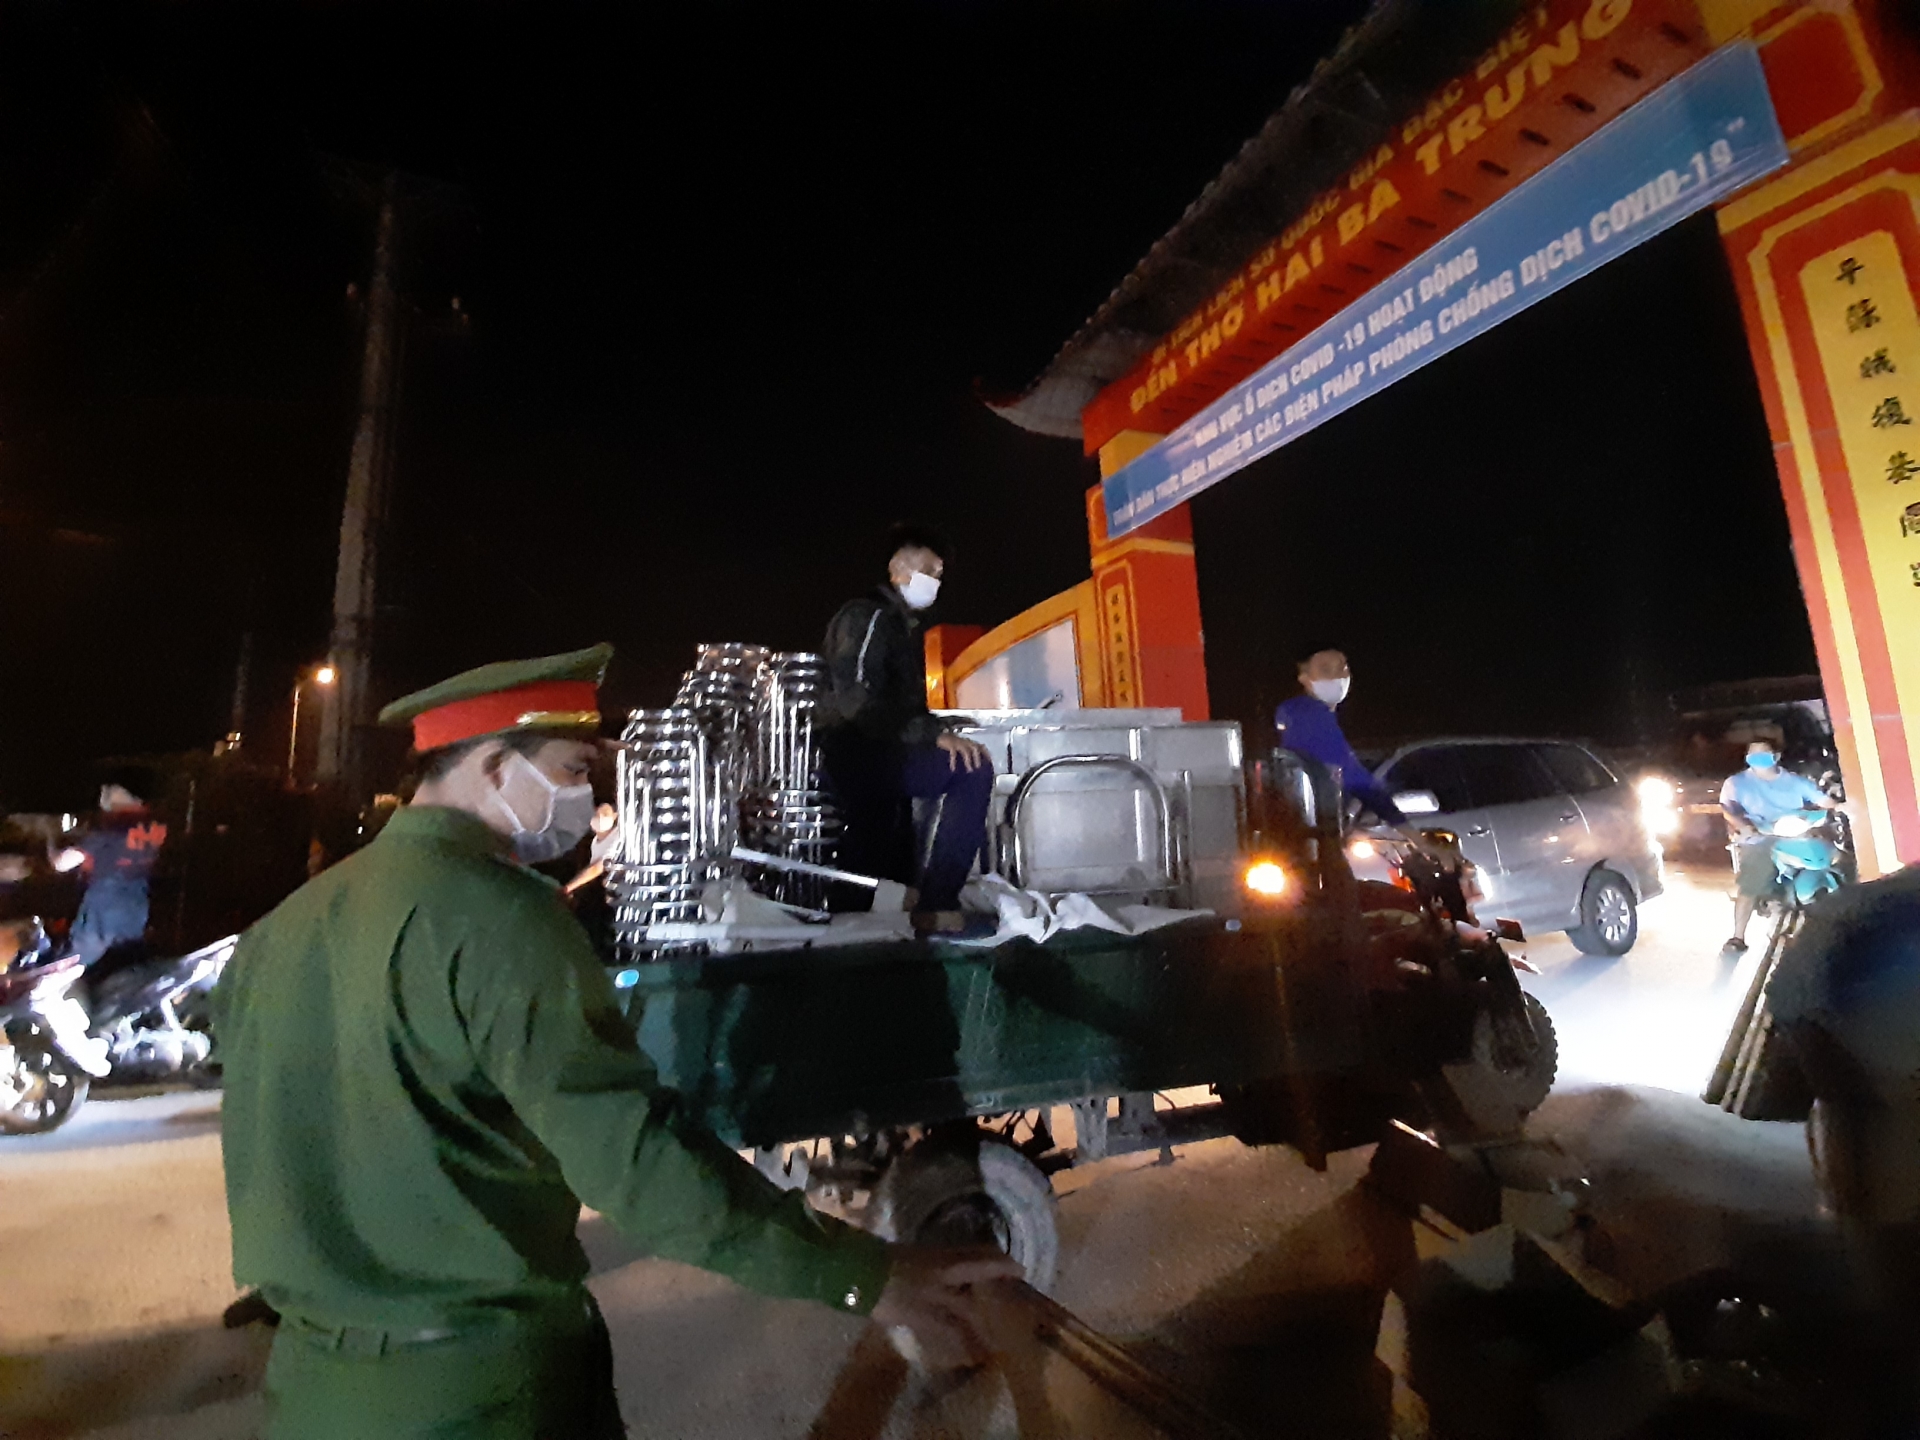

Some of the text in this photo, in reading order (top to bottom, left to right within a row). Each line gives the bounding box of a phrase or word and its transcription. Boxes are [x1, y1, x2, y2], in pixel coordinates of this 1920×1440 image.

[1255, 234, 1324, 314] HAI
[1337, 178, 1401, 246] BÀ
[1290, 343, 1335, 387] COVID
[1367, 287, 1415, 337] HOẠT
[1420, 246, 1478, 304] ĐỘNG
[1255, 410, 1283, 442] CÁC
[1284, 389, 1319, 426] BIỆN
[1322, 360, 1365, 404] PHÁP
[1369, 318, 1434, 377] PHÒNG
[1438, 268, 1516, 334] CHỐNG
[1520, 226, 1585, 287] DỊCH
